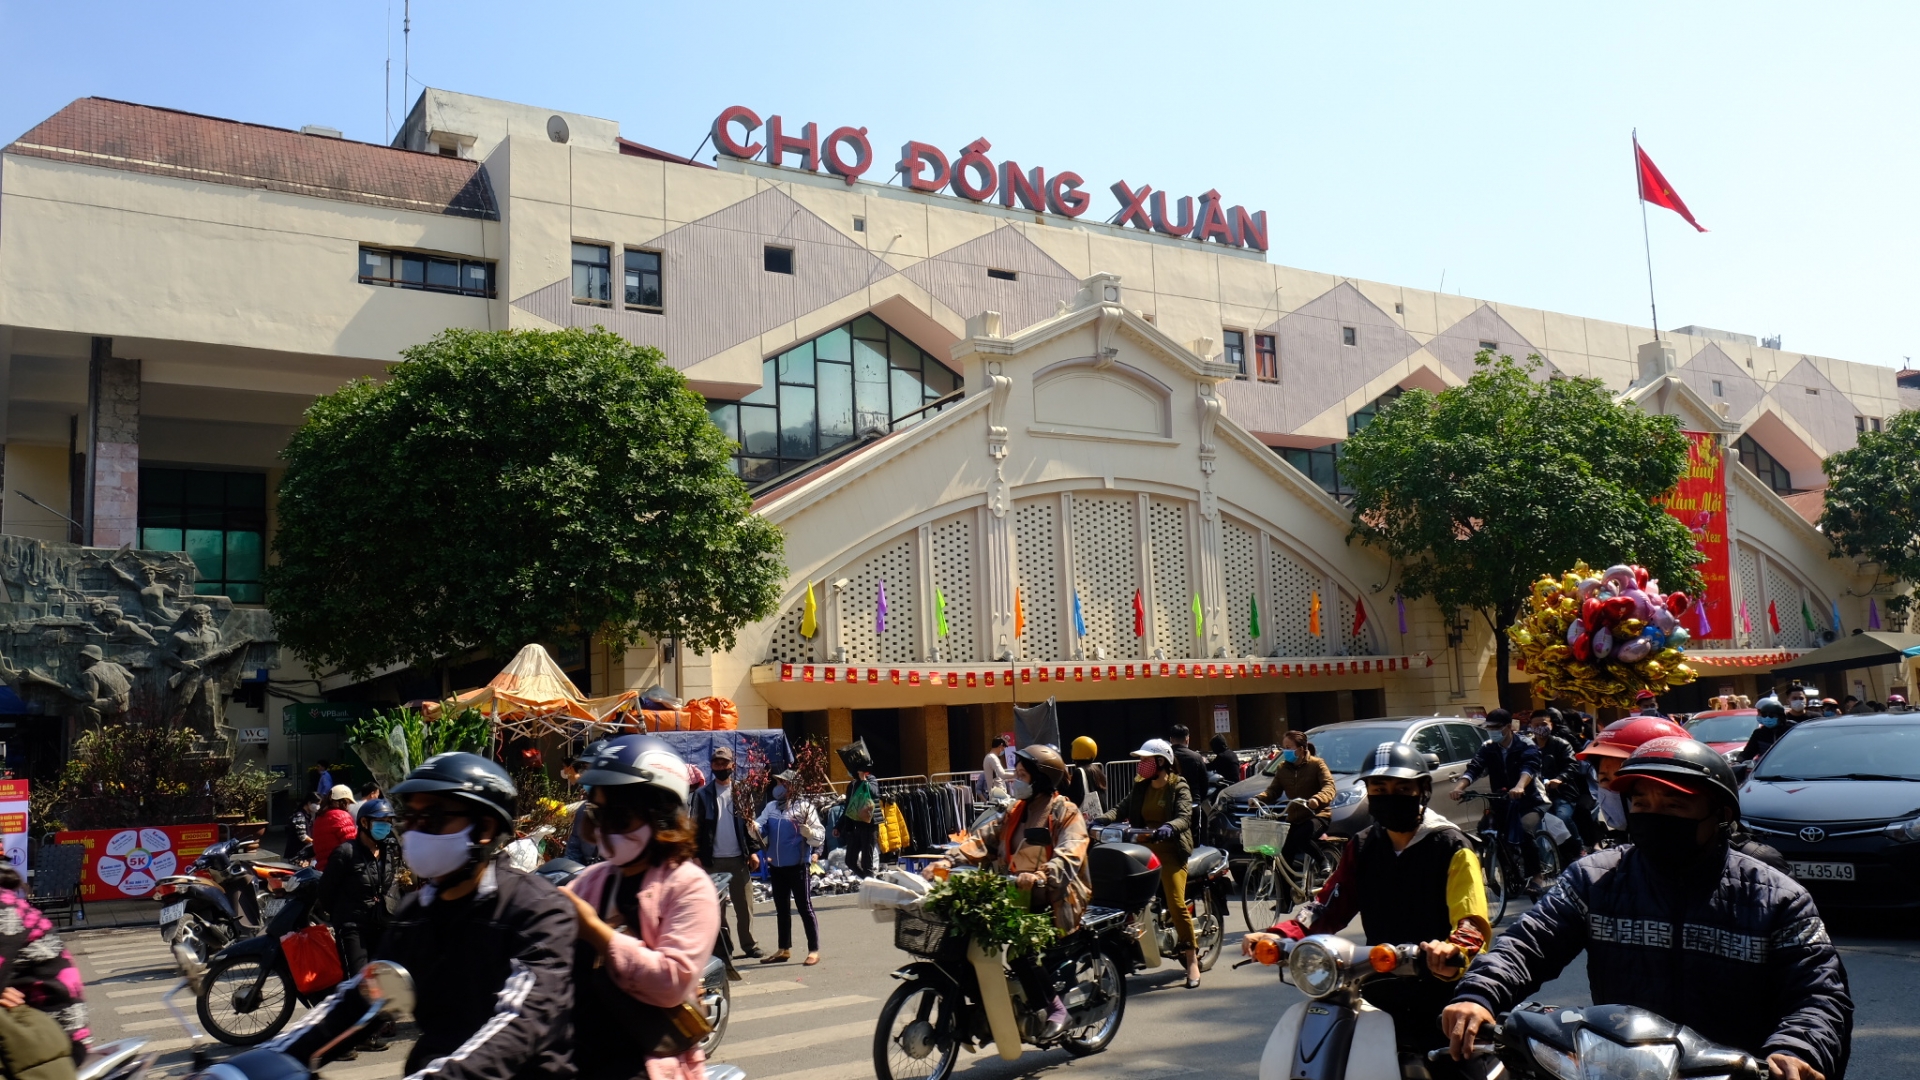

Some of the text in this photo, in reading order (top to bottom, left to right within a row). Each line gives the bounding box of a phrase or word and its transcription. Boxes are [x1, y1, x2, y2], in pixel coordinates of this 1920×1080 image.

[712, 105, 873, 186] CHỢ
[1110, 179, 1268, 251] XUÂN
[1704, 530, 1722, 543] Year
[244, 729, 265, 737] WC
[129, 857, 146, 866] 5K
